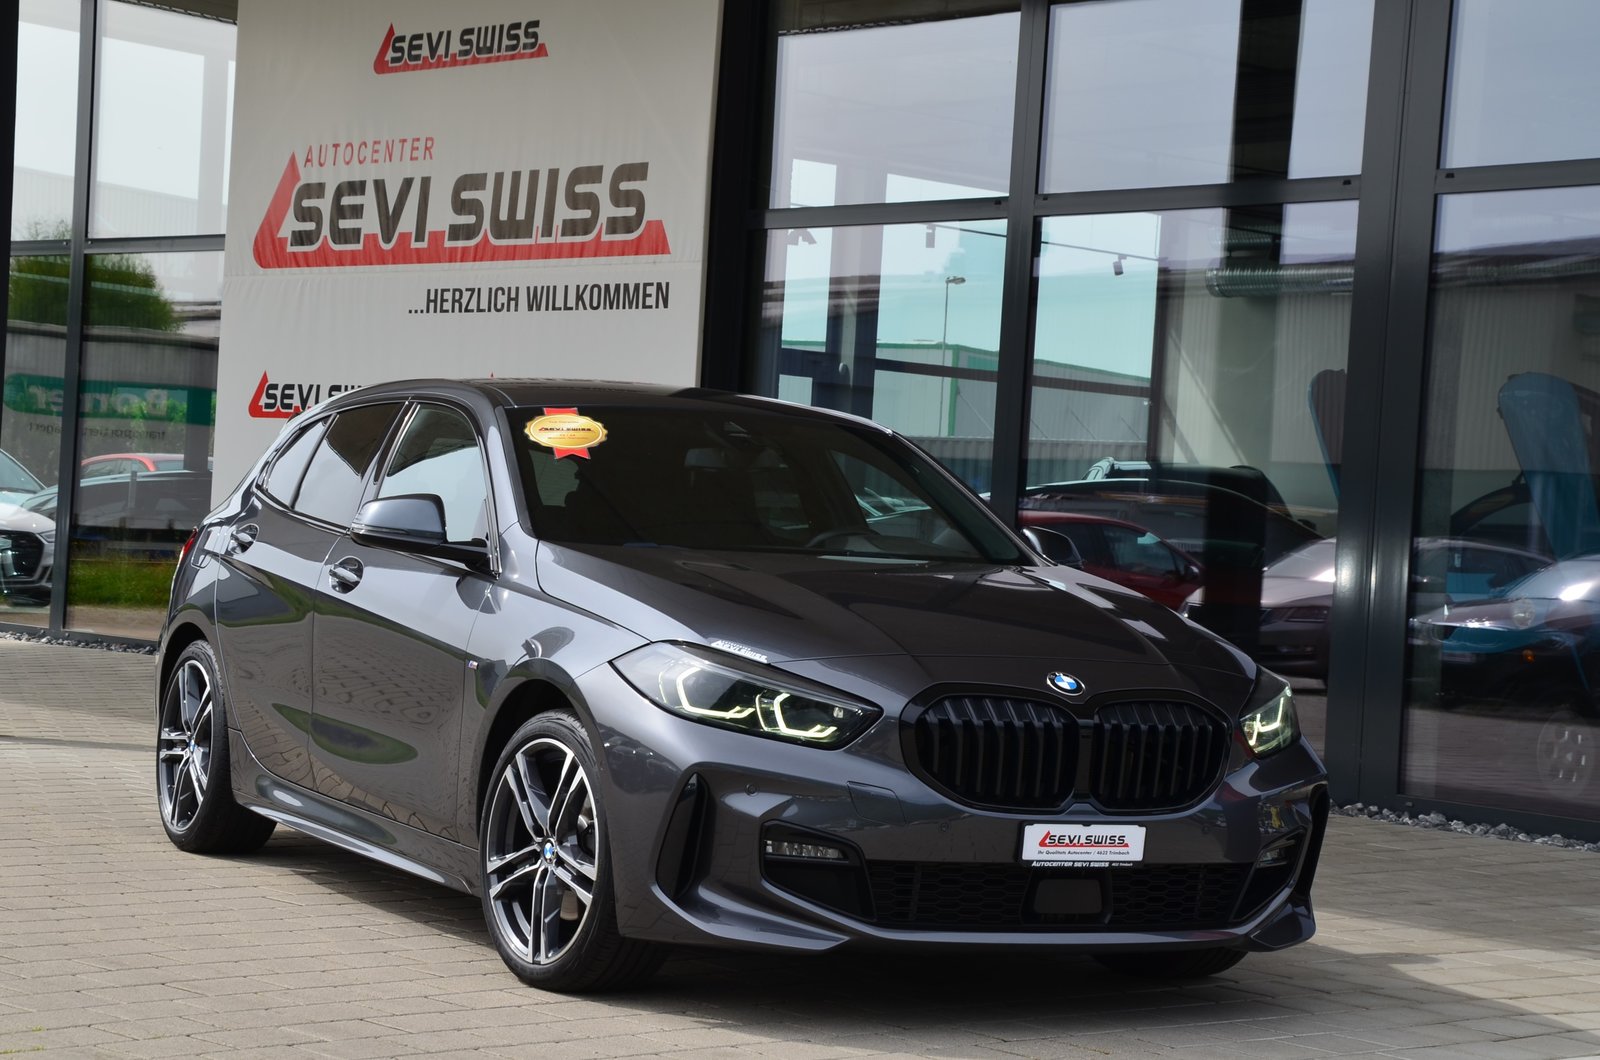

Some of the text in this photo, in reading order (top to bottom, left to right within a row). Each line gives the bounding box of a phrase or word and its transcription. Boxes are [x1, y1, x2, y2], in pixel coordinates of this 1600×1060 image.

[389, 20, 540, 64] SEVI SWISS
[304, 136, 435, 168] AUTOCENTER
[289, 162, 649, 248] SEVI SWISS
[526, 282, 671, 313] WILLKOMMEN
[263, 383, 321, 411] SEVI
[1047, 834, 1126, 845] SEVI SWISS
